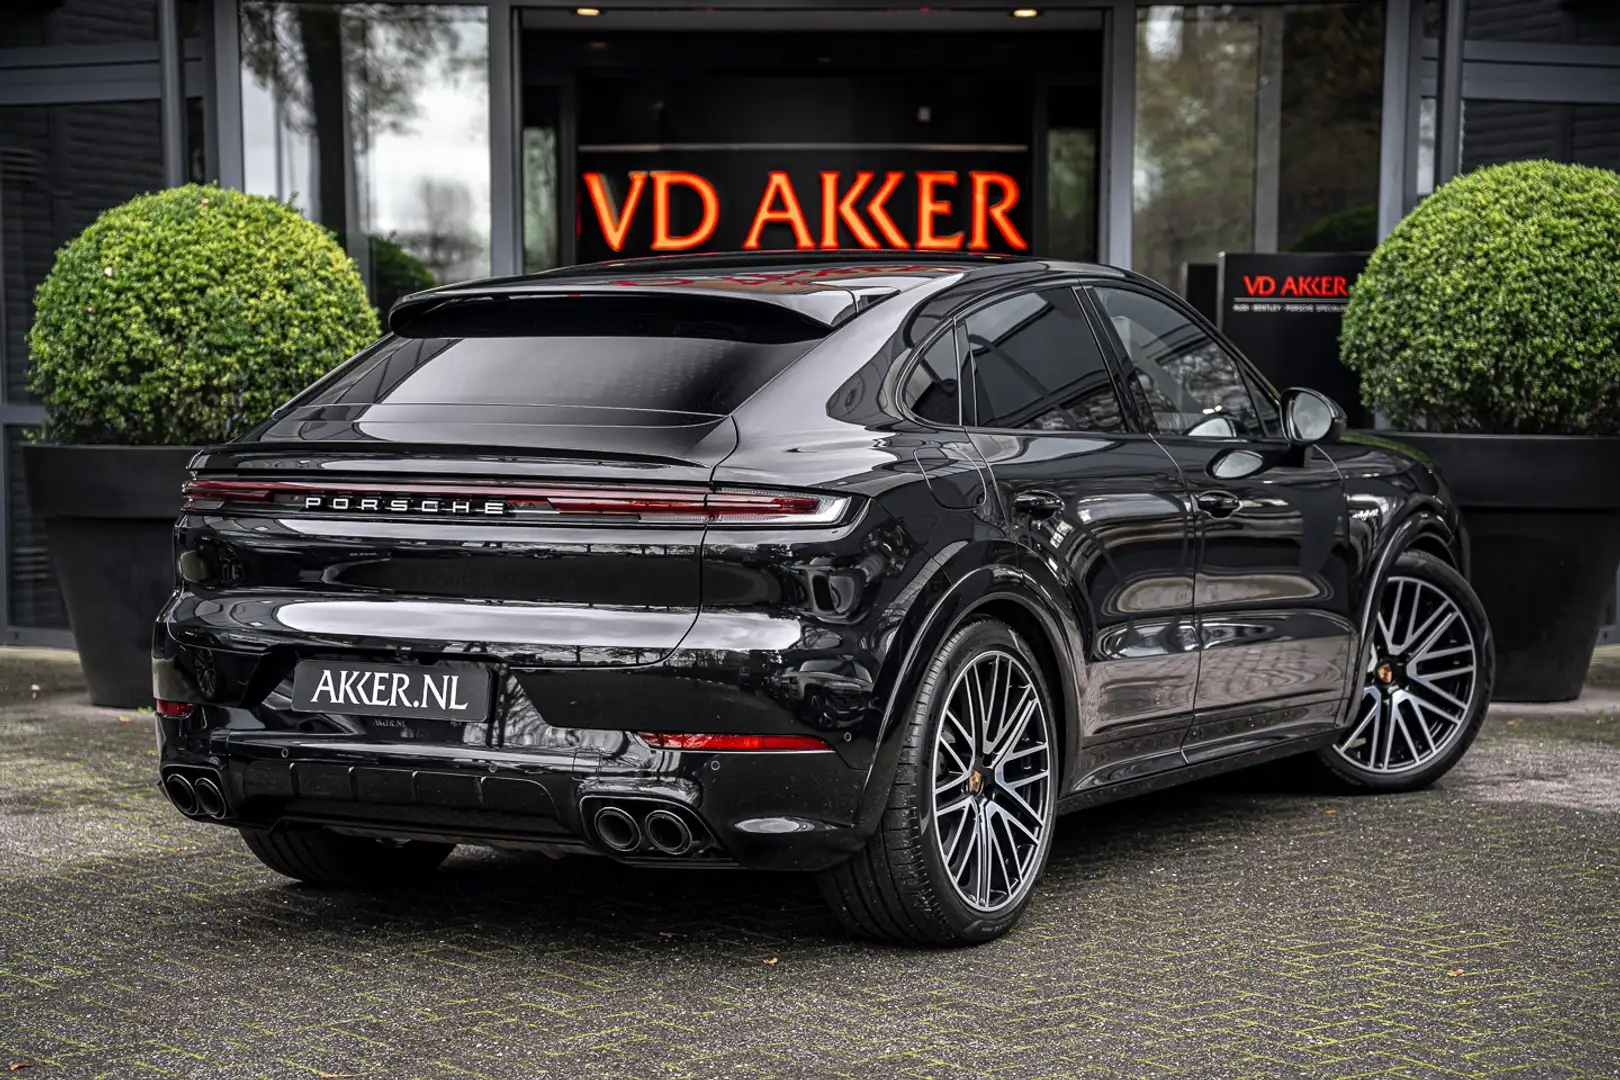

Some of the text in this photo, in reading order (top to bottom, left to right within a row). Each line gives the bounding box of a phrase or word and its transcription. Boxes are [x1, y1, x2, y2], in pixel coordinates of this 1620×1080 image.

[582, 169, 1029, 252] VD AKKER
[1242, 274, 1349, 297] VD AKKER
[305, 497, 504, 514] PORSCHE
[310, 669, 469, 710] AKKER.NL
